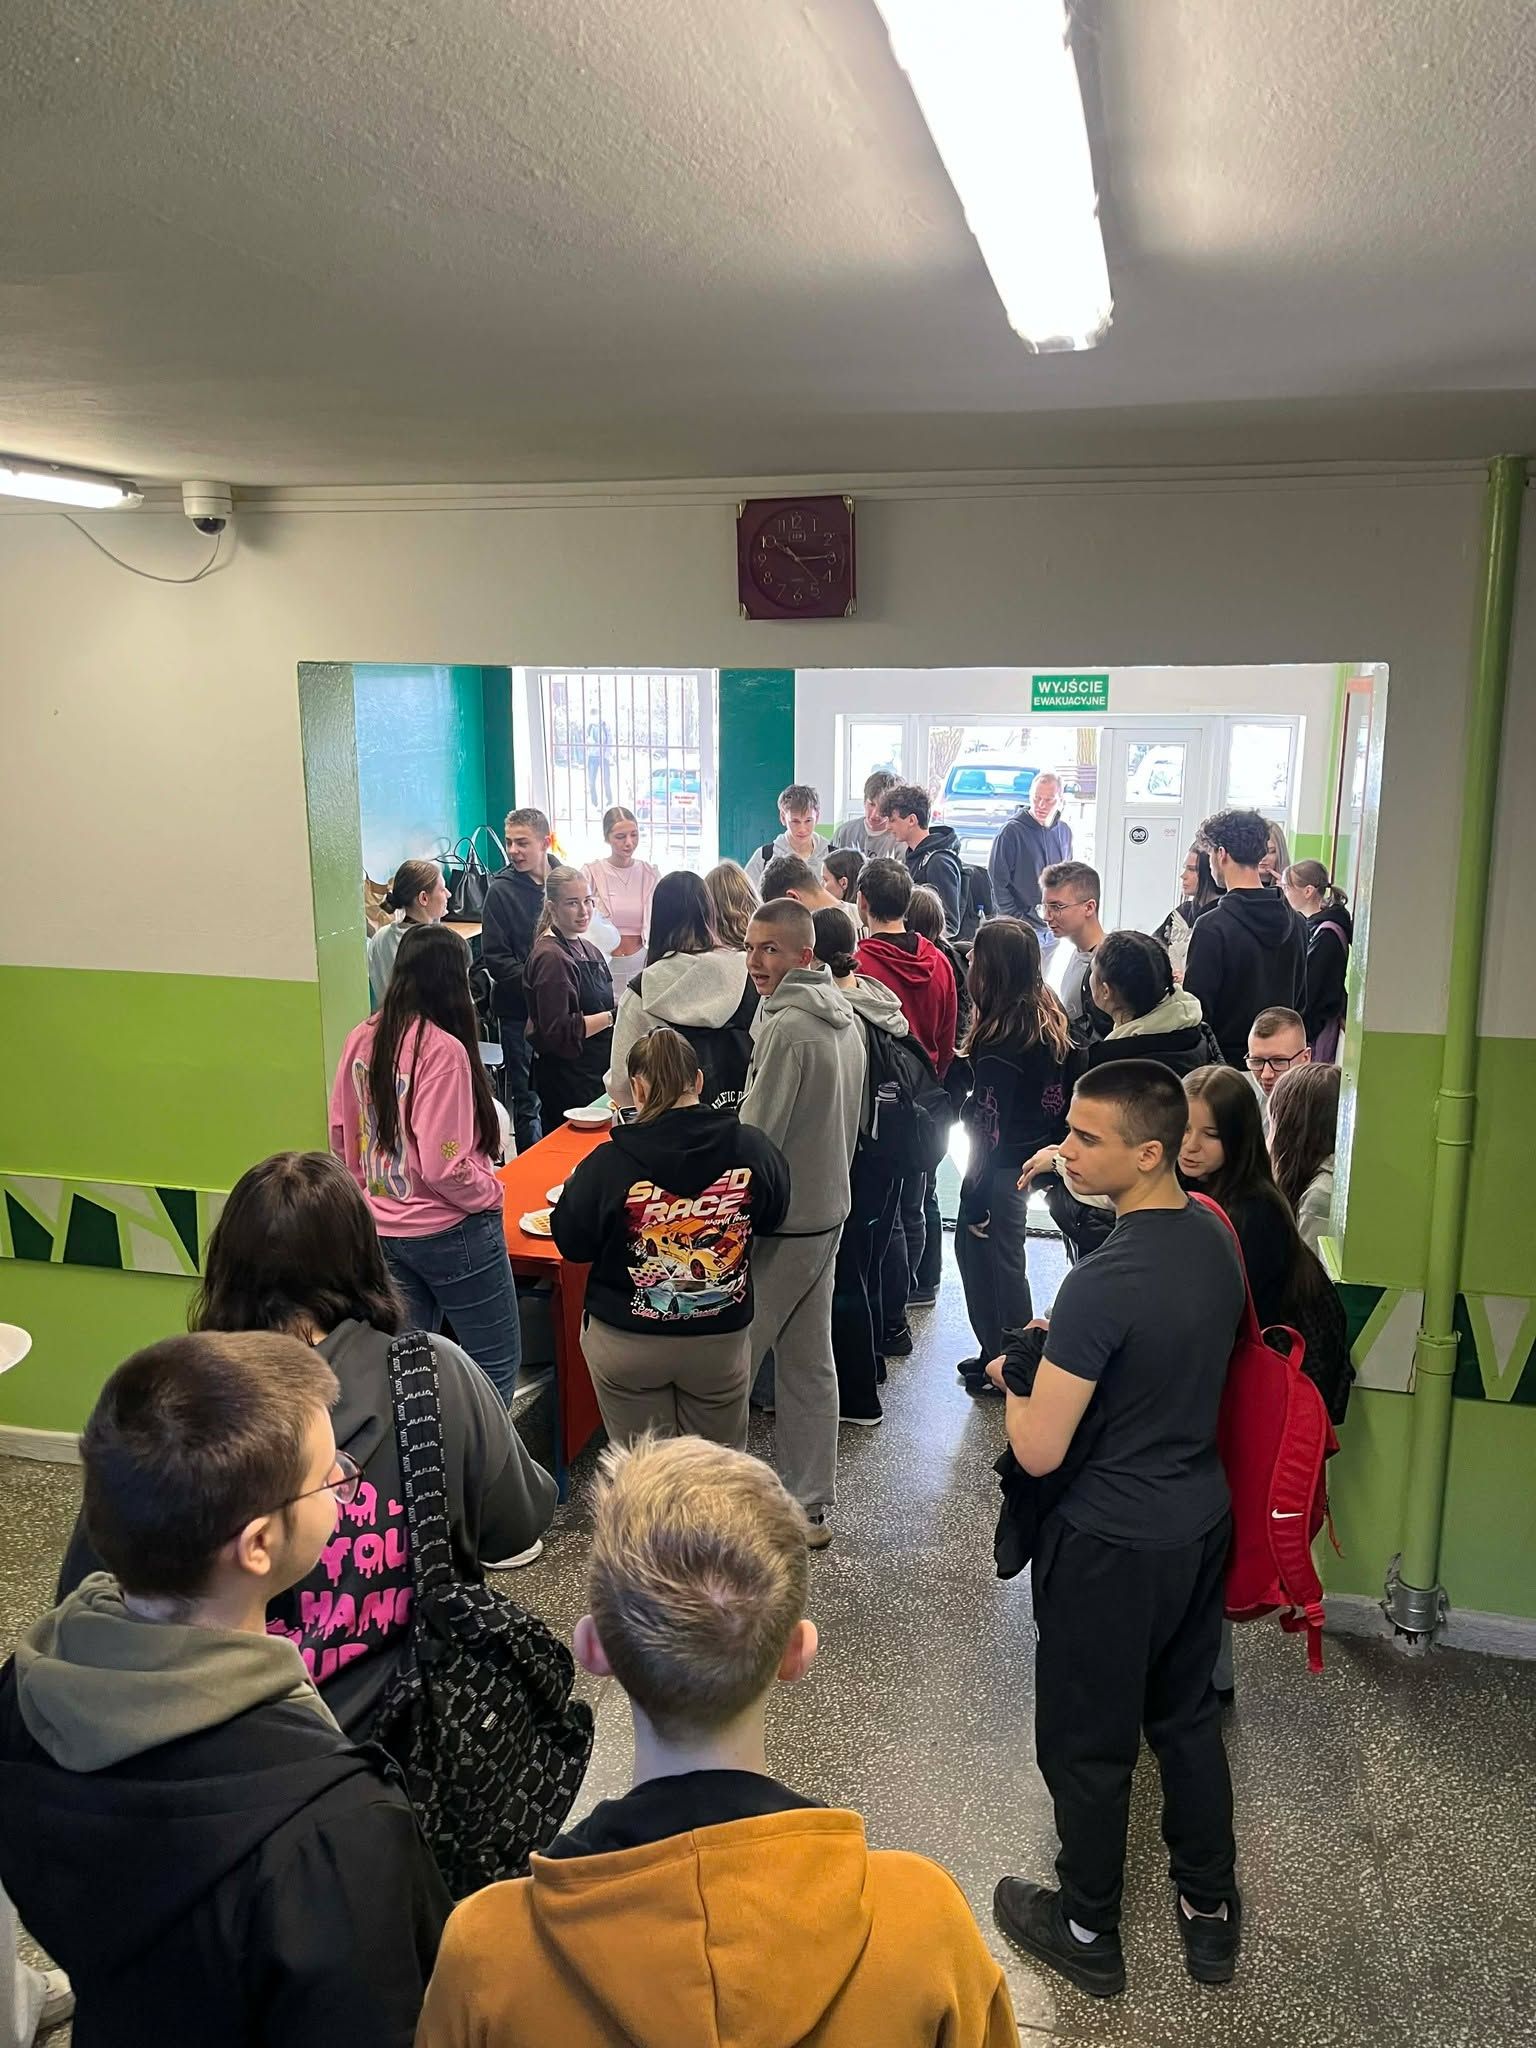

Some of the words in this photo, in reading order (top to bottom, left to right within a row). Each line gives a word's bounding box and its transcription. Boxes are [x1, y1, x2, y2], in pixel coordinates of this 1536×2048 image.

[1038, 678, 1103, 694] WYJŚCIE
[1033, 695, 1106, 706] EWAKUACYJNE
[641, 1192, 745, 1223] RACE
